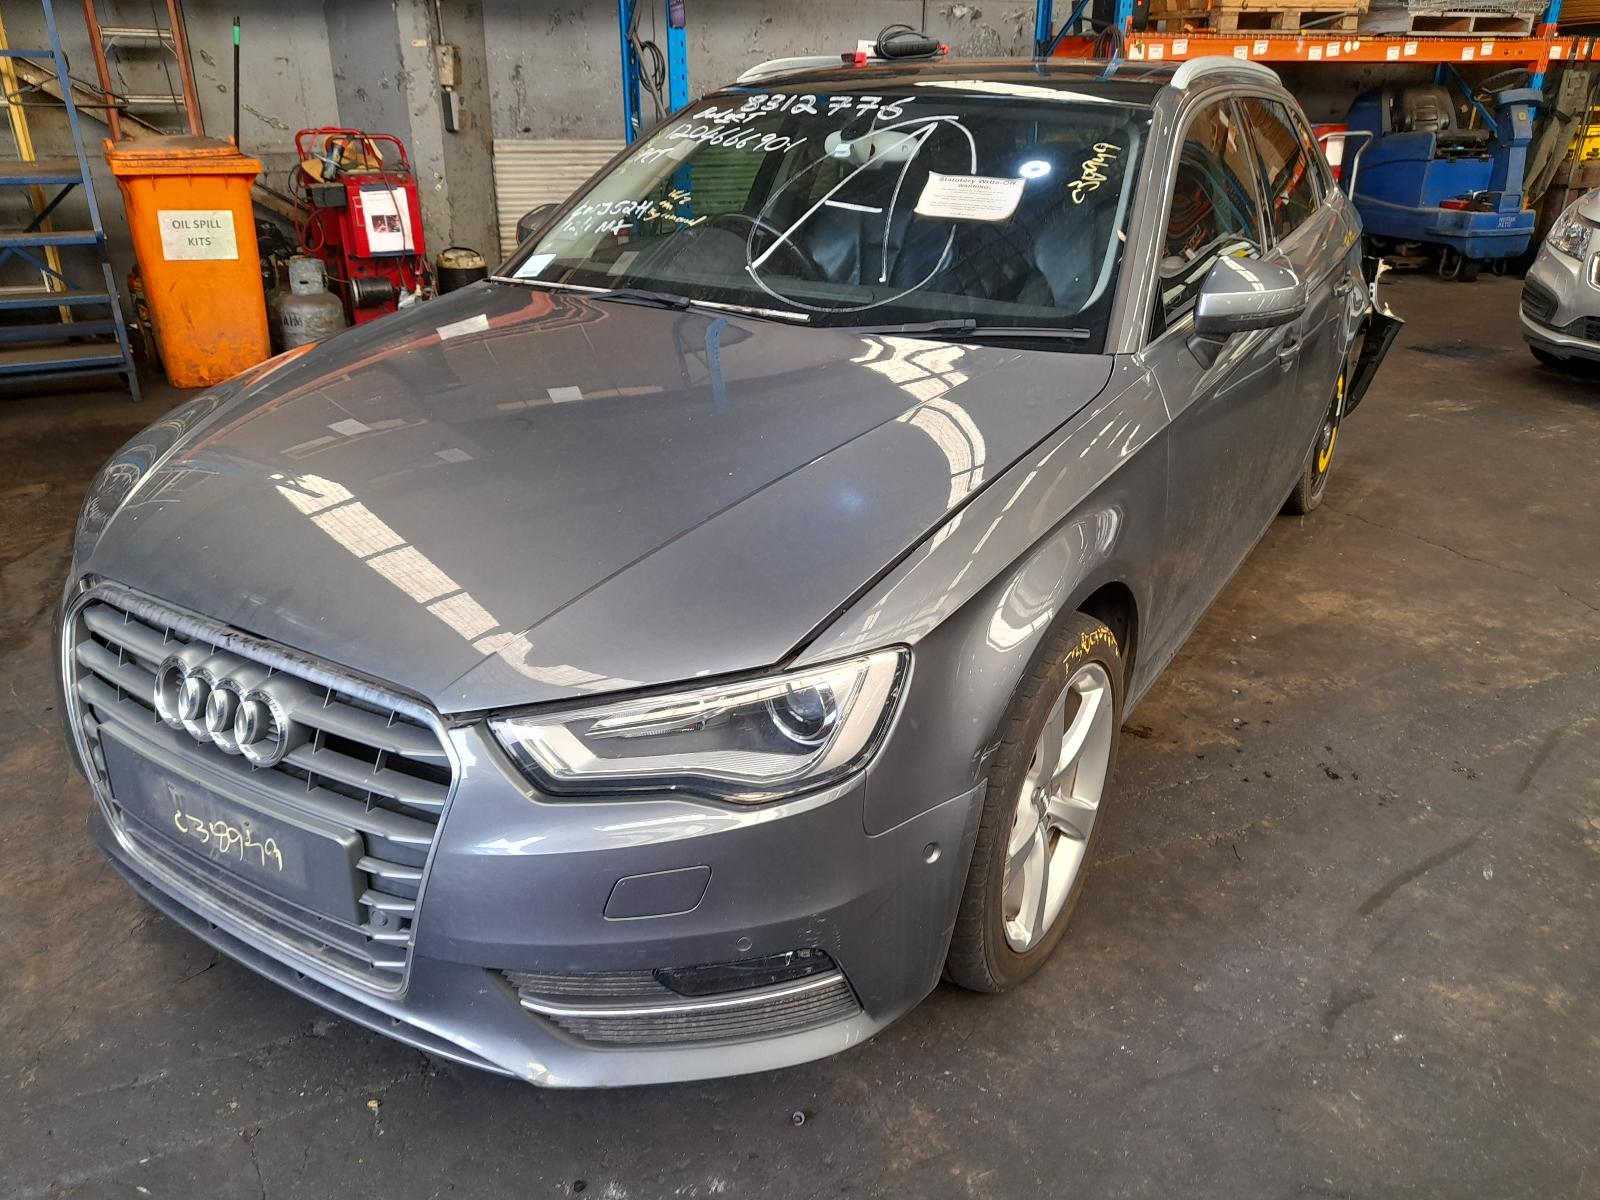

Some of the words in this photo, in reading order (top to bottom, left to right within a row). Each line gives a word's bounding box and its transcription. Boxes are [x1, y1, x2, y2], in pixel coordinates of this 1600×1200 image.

[938, 176, 977, 184] Statutory
[171, 219, 191, 230] OIL
[193, 219, 222, 229] SPILL
[187, 236, 212, 247] KITS
